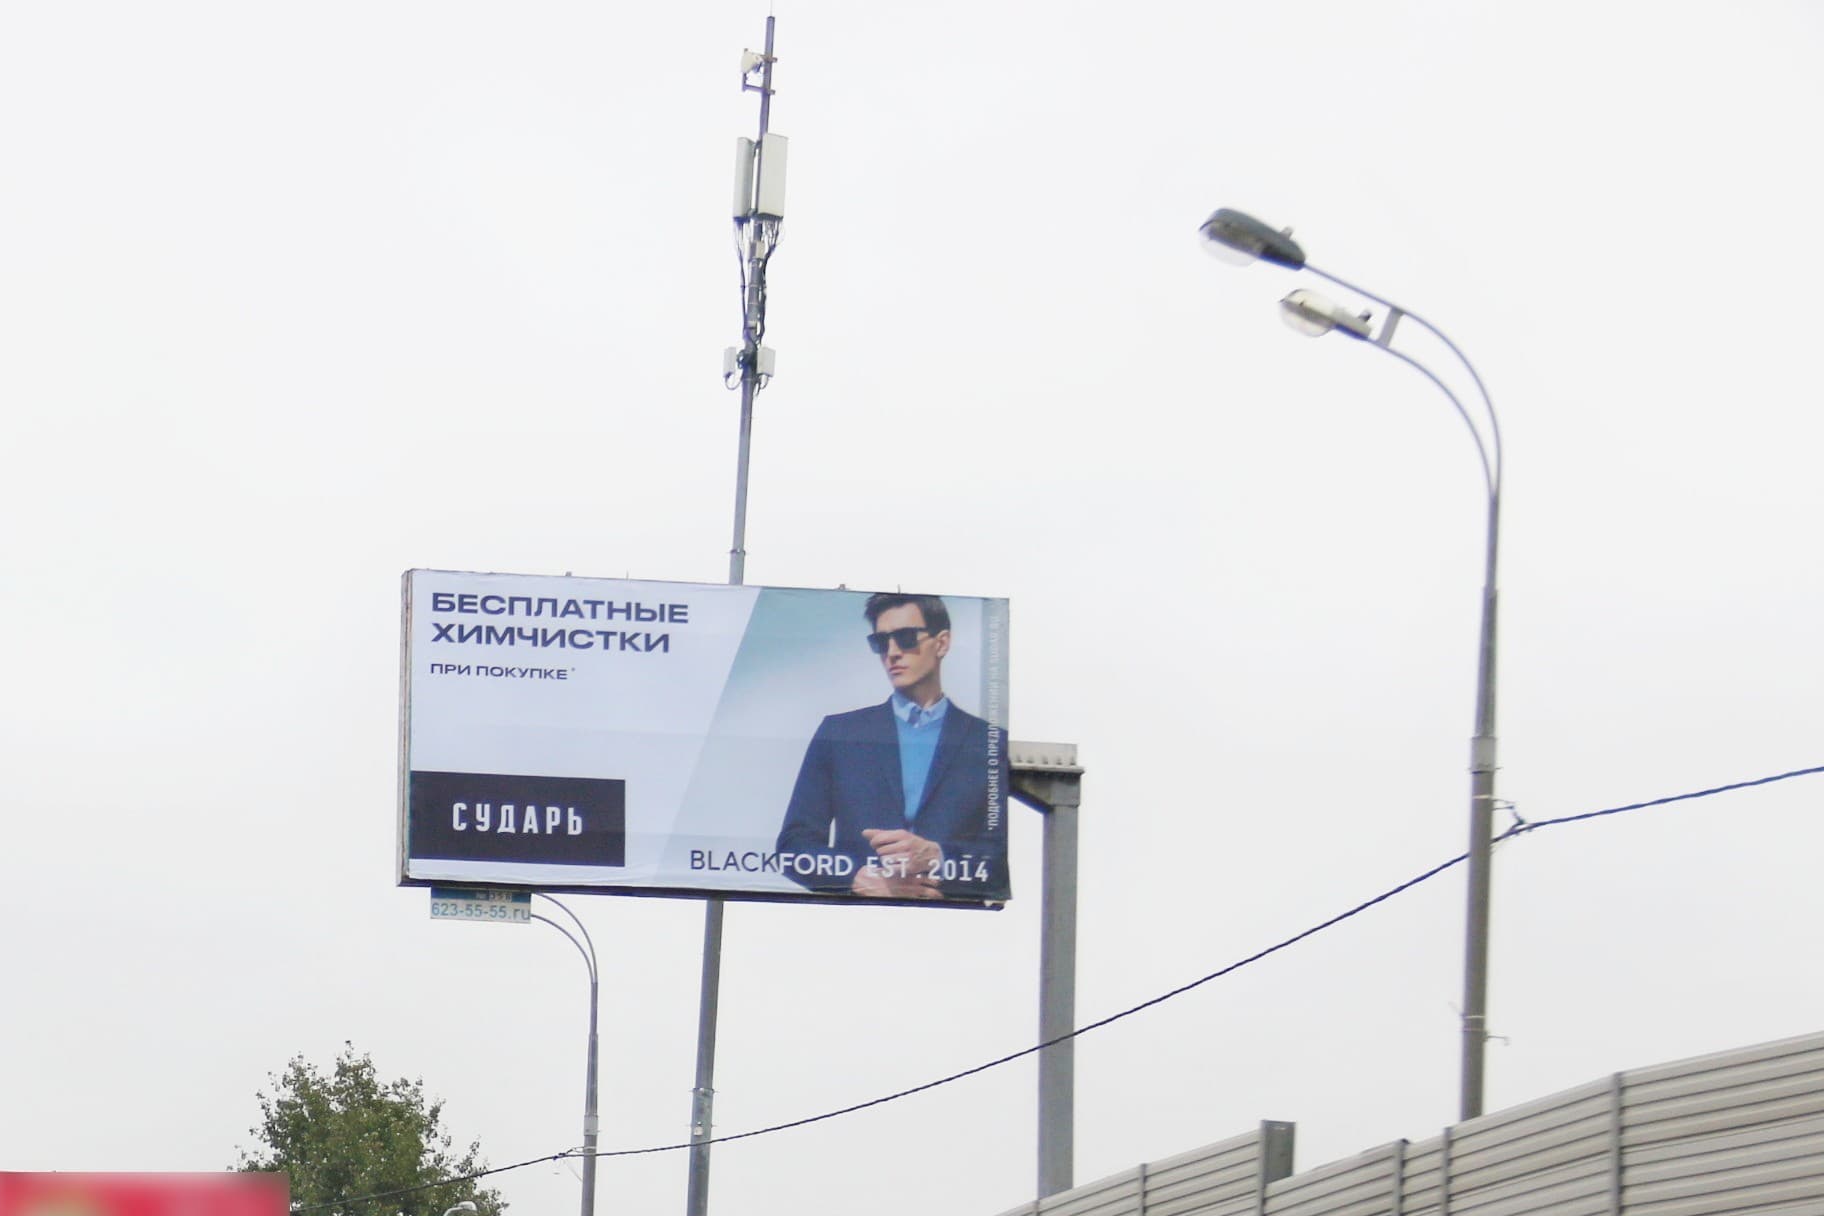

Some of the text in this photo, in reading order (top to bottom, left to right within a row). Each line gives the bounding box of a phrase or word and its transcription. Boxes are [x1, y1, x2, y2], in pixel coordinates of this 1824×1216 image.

[432, 592, 689, 624] БЕСПЛАТНЫЕ
[431, 622, 670, 653] ХИМЧИСТКИ
[430, 663, 471, 676] ПРИ
[452, 802, 583, 836] СУДАРЬ
[690, 850, 854, 877] BLACKFORD
[431, 902, 531, 921] 623-55-55.ru
